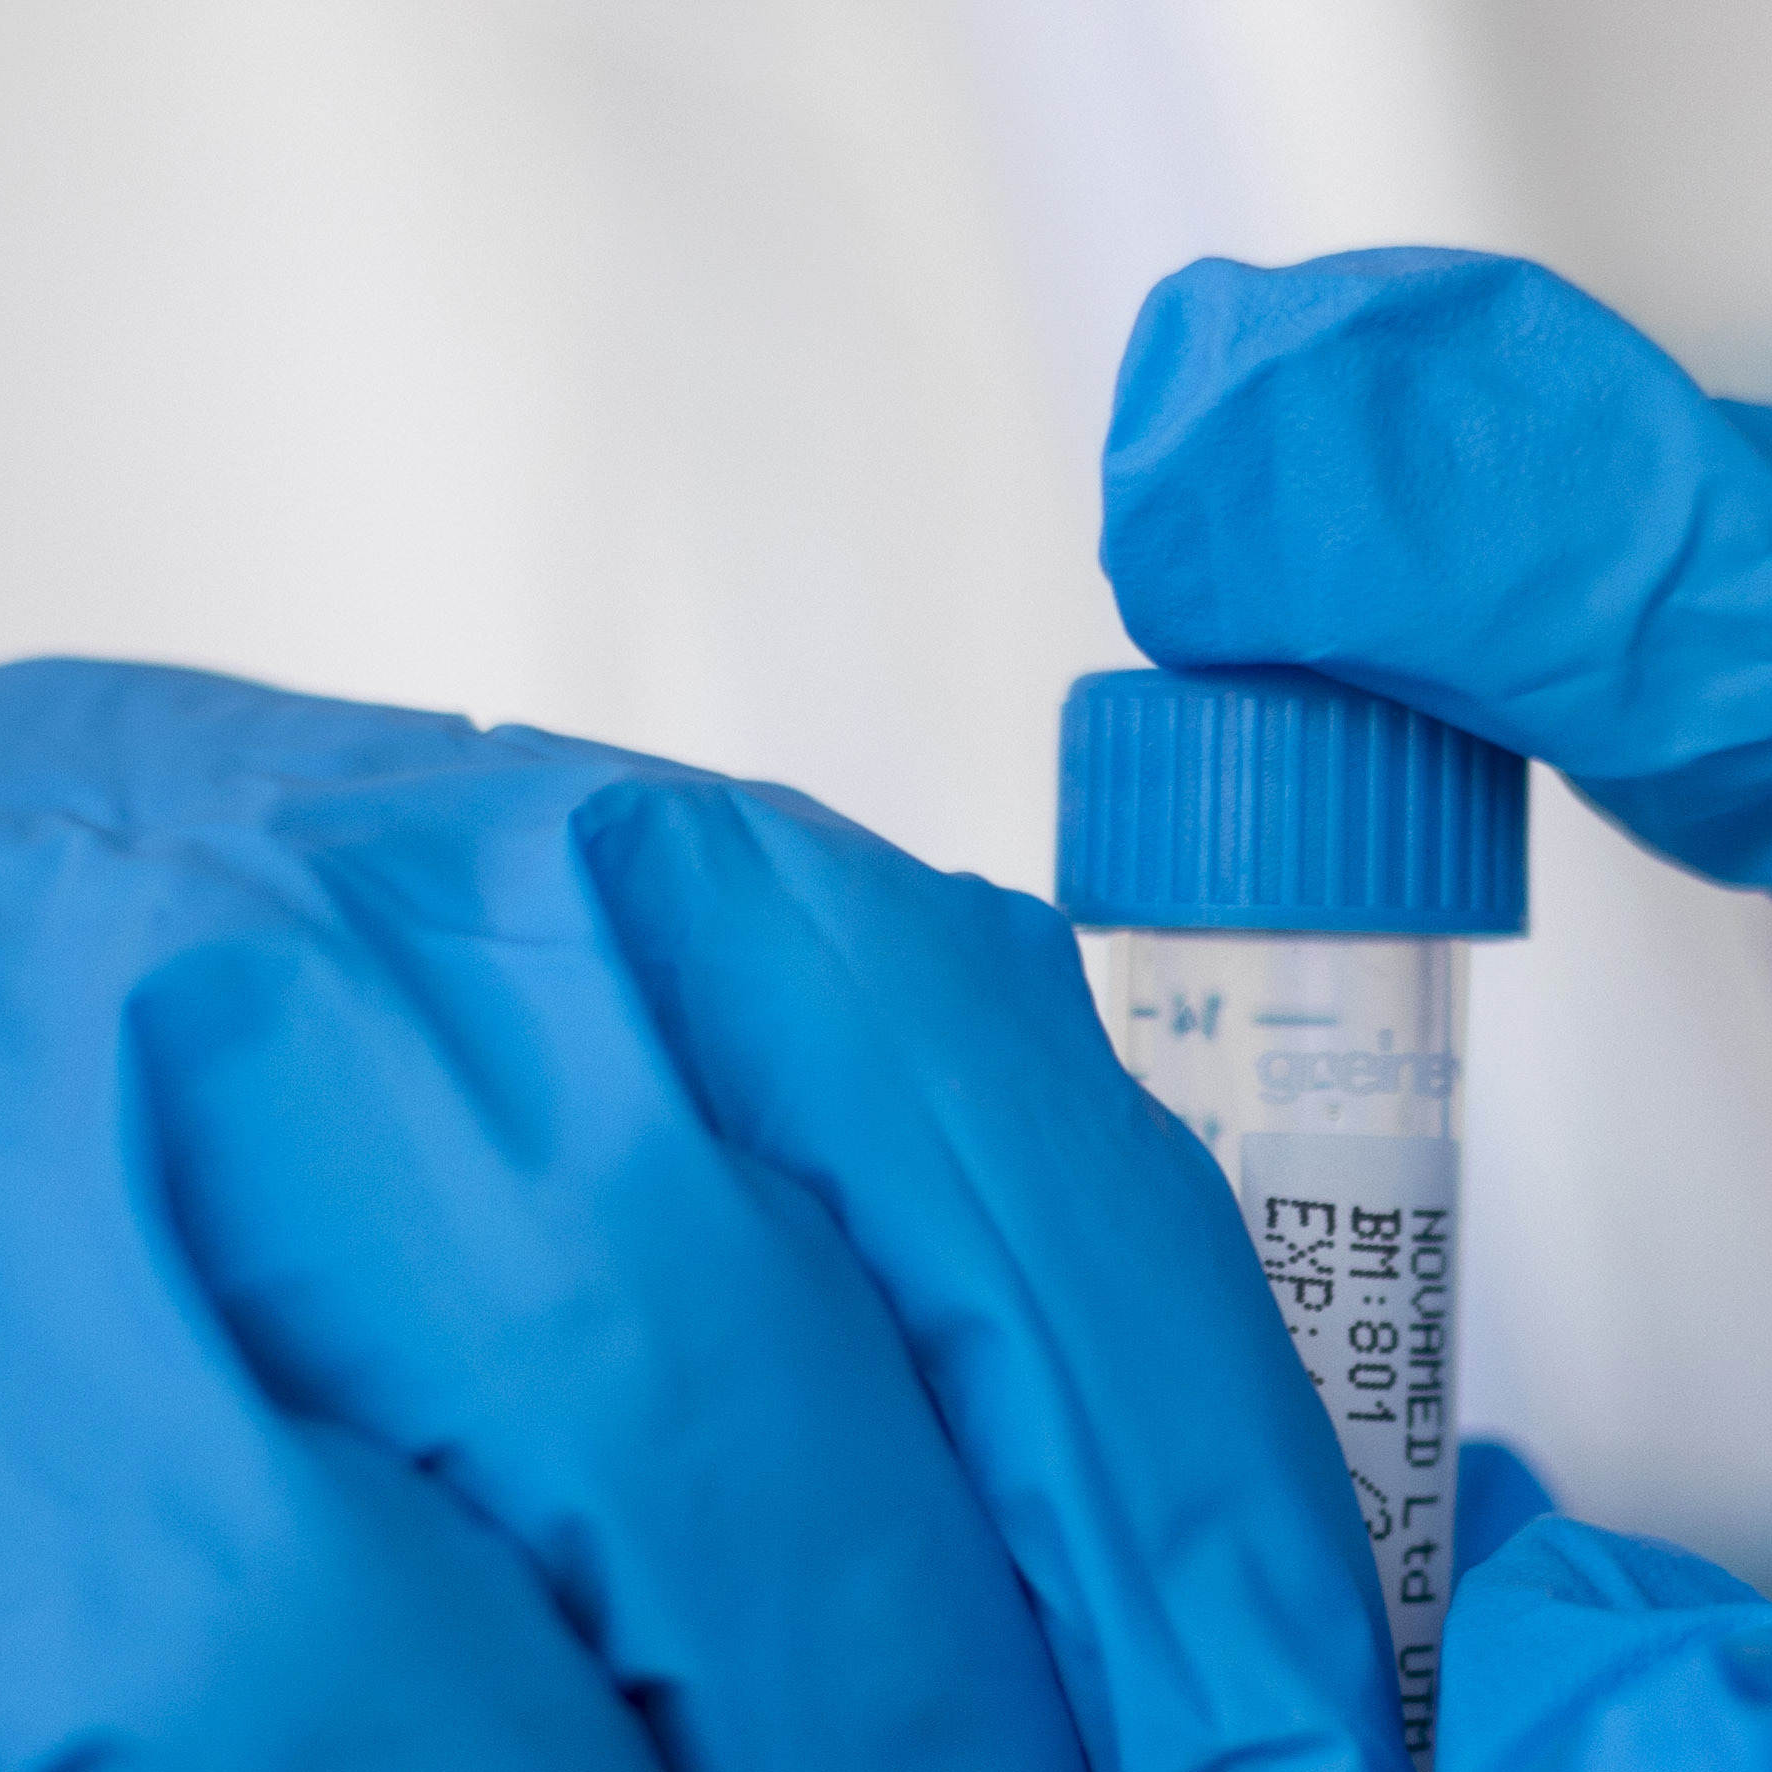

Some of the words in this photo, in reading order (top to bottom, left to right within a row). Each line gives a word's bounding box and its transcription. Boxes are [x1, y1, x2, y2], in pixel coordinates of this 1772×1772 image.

[1264, 1197, 1335, 1386] EXP:
[1347, 1206, 1401, 1422] BM:801
[1405, 1208, 1447, 1467] NOVAMED
[1401, 1495, 1440, 1604] Ltd
